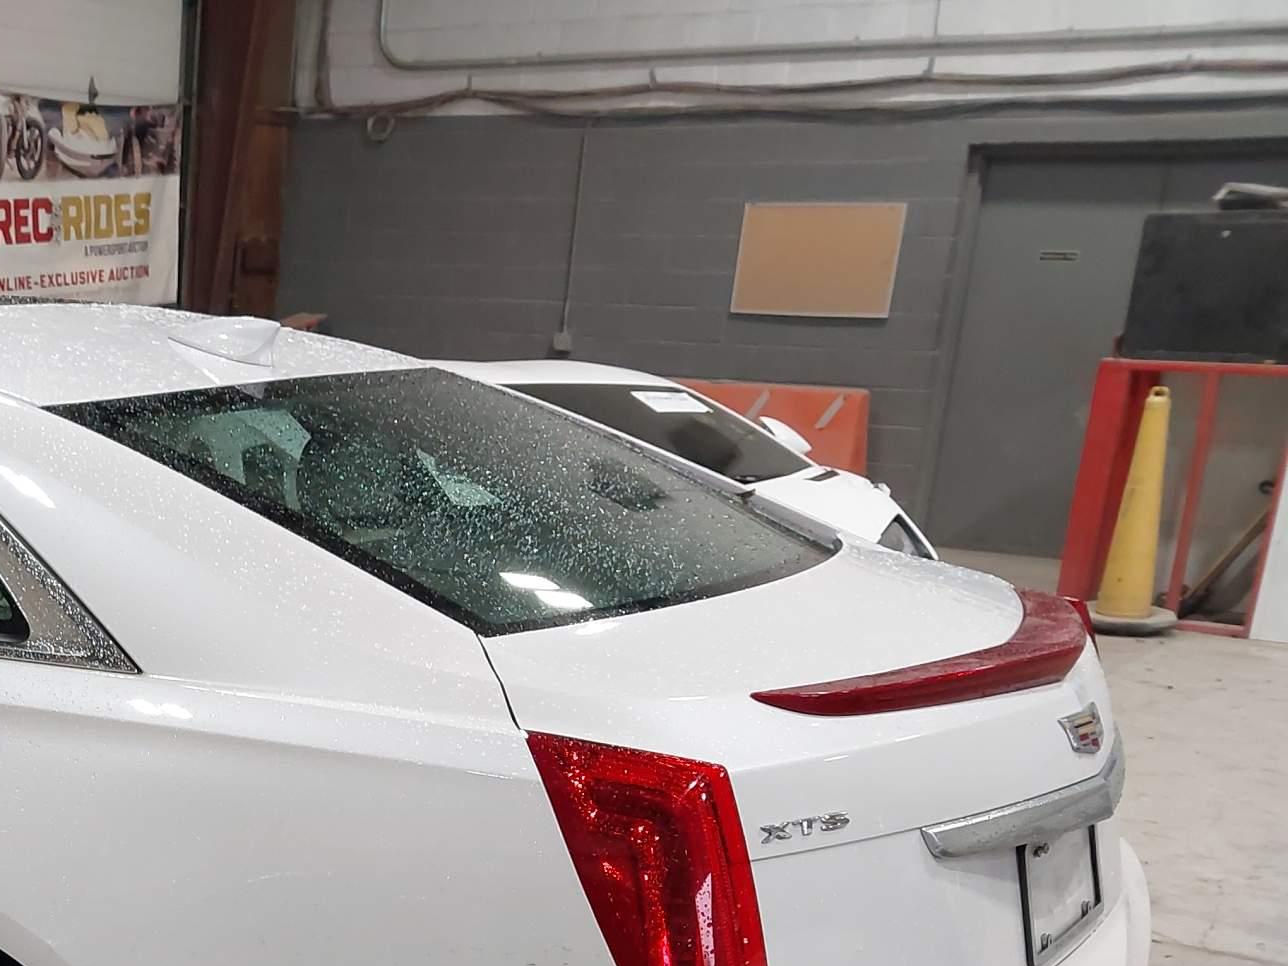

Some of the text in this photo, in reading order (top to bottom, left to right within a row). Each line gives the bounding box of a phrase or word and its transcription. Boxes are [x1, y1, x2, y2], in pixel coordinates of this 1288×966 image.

[60, 191, 152, 242] RIDES
[107, 263, 150, 283] AUCTION
[759, 810, 851, 844] XTS
